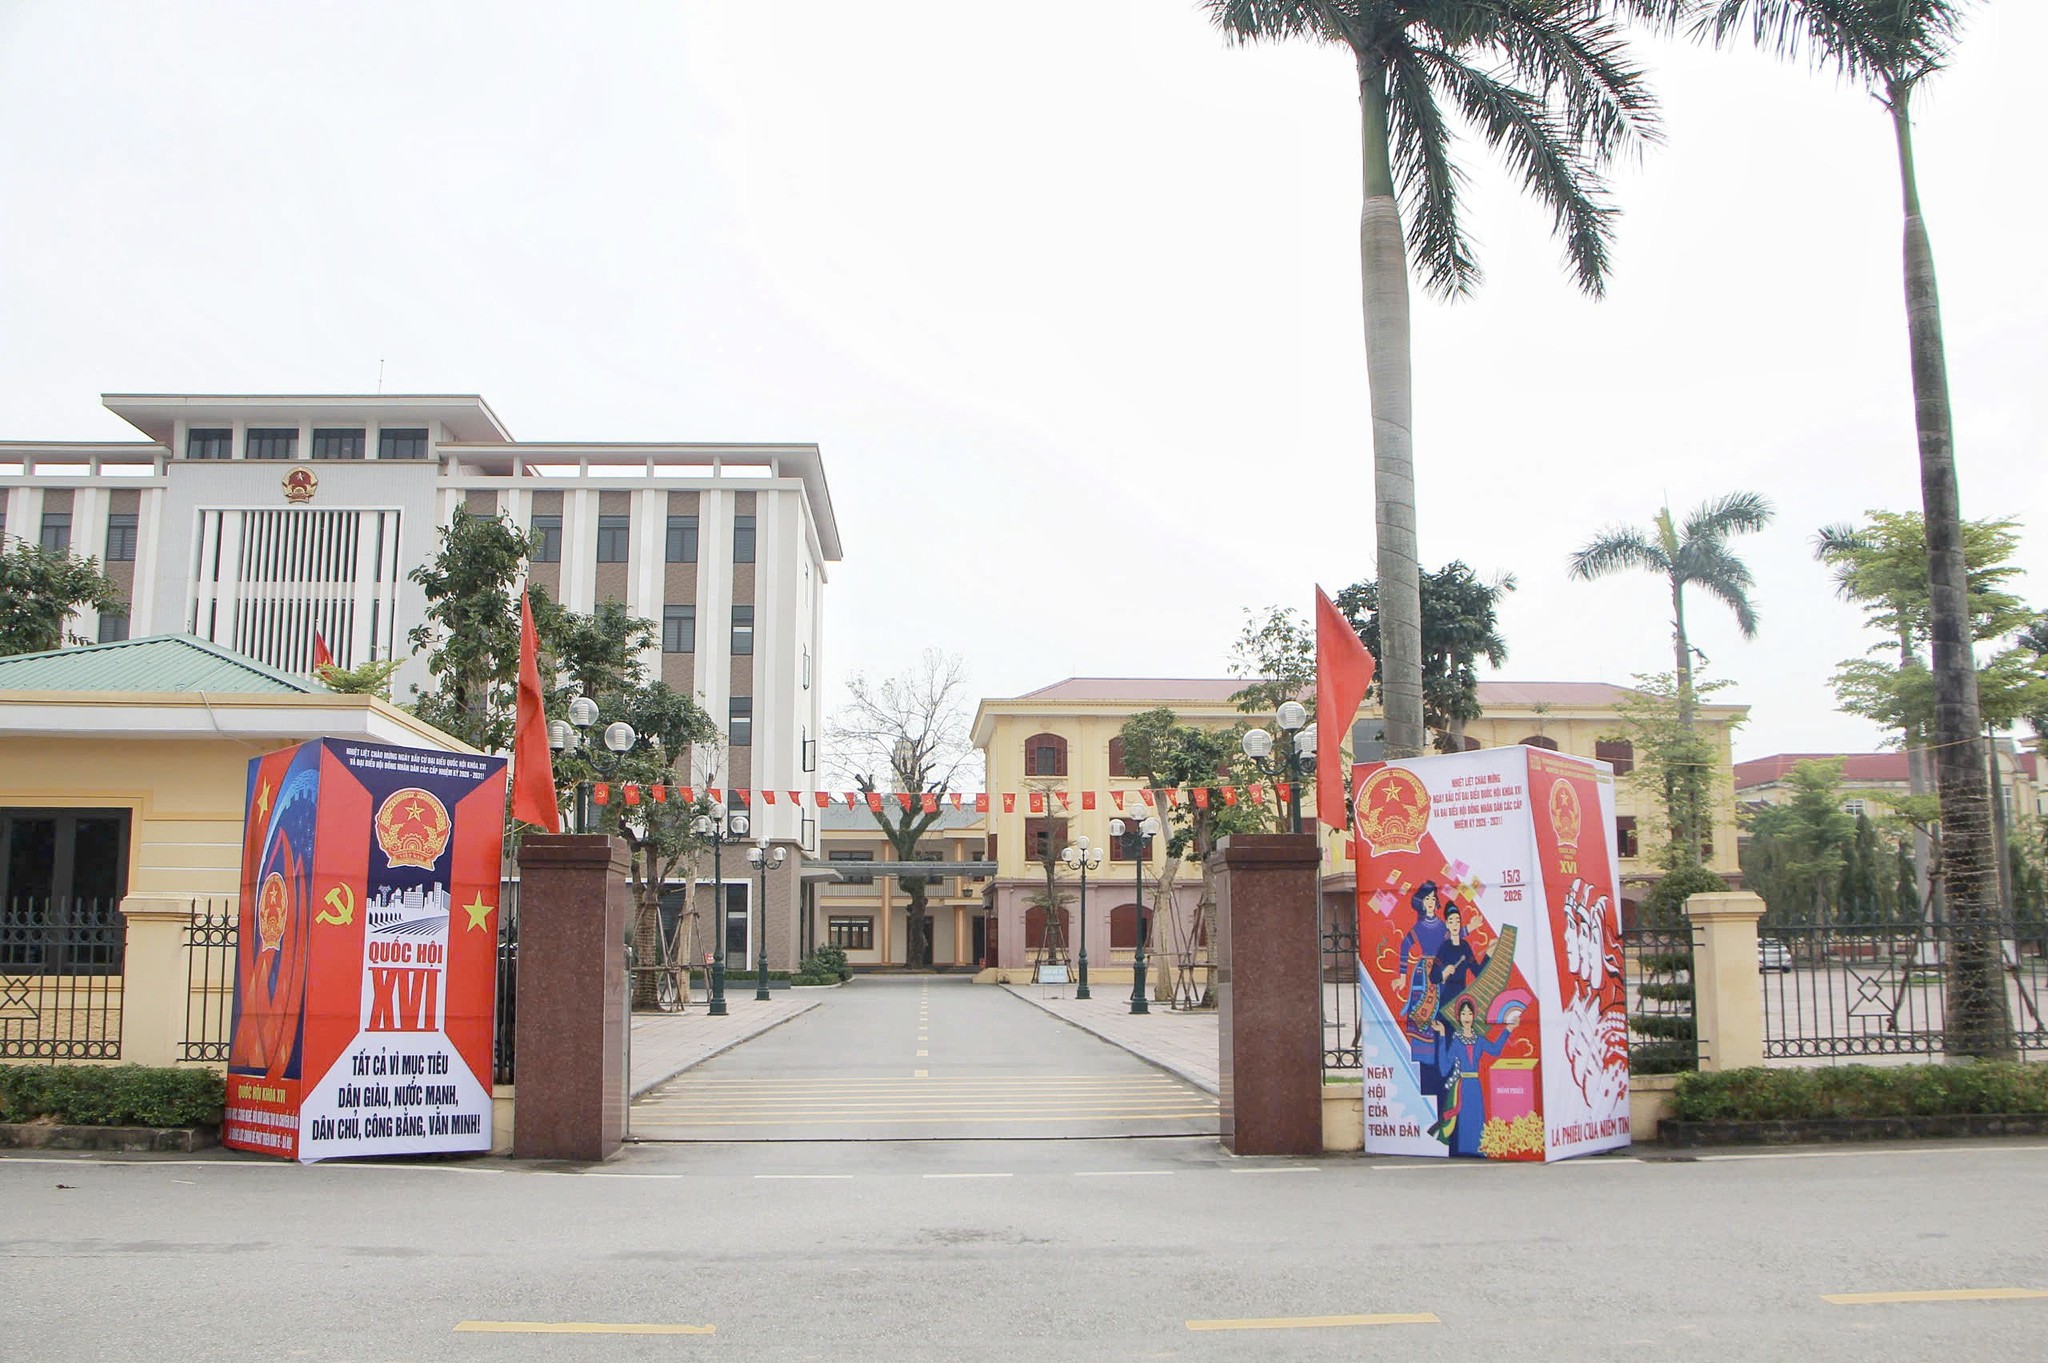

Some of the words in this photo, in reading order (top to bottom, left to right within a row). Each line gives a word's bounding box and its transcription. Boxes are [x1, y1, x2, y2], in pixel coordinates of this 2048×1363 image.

[1560, 861, 1577, 874] XVI
[1502, 869, 1520, 883] 15/3
[1504, 890, 1522, 901] 2026
[369, 936, 411, 964] QUỐC
[417, 941, 443, 967] HỘI
[365, 967, 441, 1032] XVI
[353, 1049, 370, 1076] TẤT
[373, 1047, 386, 1075] CẢ
[390, 1052, 399, 1075] VÌ
[402, 1055, 424, 1079] MỤC
[428, 1051, 448, 1074] TIÊU
[1368, 1064, 1393, 1079] NGÀY
[339, 1083, 360, 1108] DÂN
[364, 1082, 391, 1109] GIÀU,
[395, 1080, 422, 1106] NƯỚC
[426, 1085, 458, 1109] MẠNH,
[1368, 1084, 1385, 1100] HỘI
[1369, 1102, 1388, 1117] CỦA
[312, 1115, 334, 1140] DÂN
[338, 1110, 361, 1141] CHỦ,
[365, 1113, 392, 1138] CÔNG
[396, 1108, 425, 1138] BẰNG,
[429, 1112, 448, 1135] VĂN
[452, 1114, 480, 1135] MINH!
[1369, 1122, 1395, 1136] TOÀN
[1400, 1122, 1420, 1137] DÂN
[1552, 1123, 1560, 1146] LÁ
[1563, 1120, 1582, 1145] PHIẾU
[1584, 1116, 1599, 1140] CỦA
[1618, 1116, 1629, 1134] TIN
